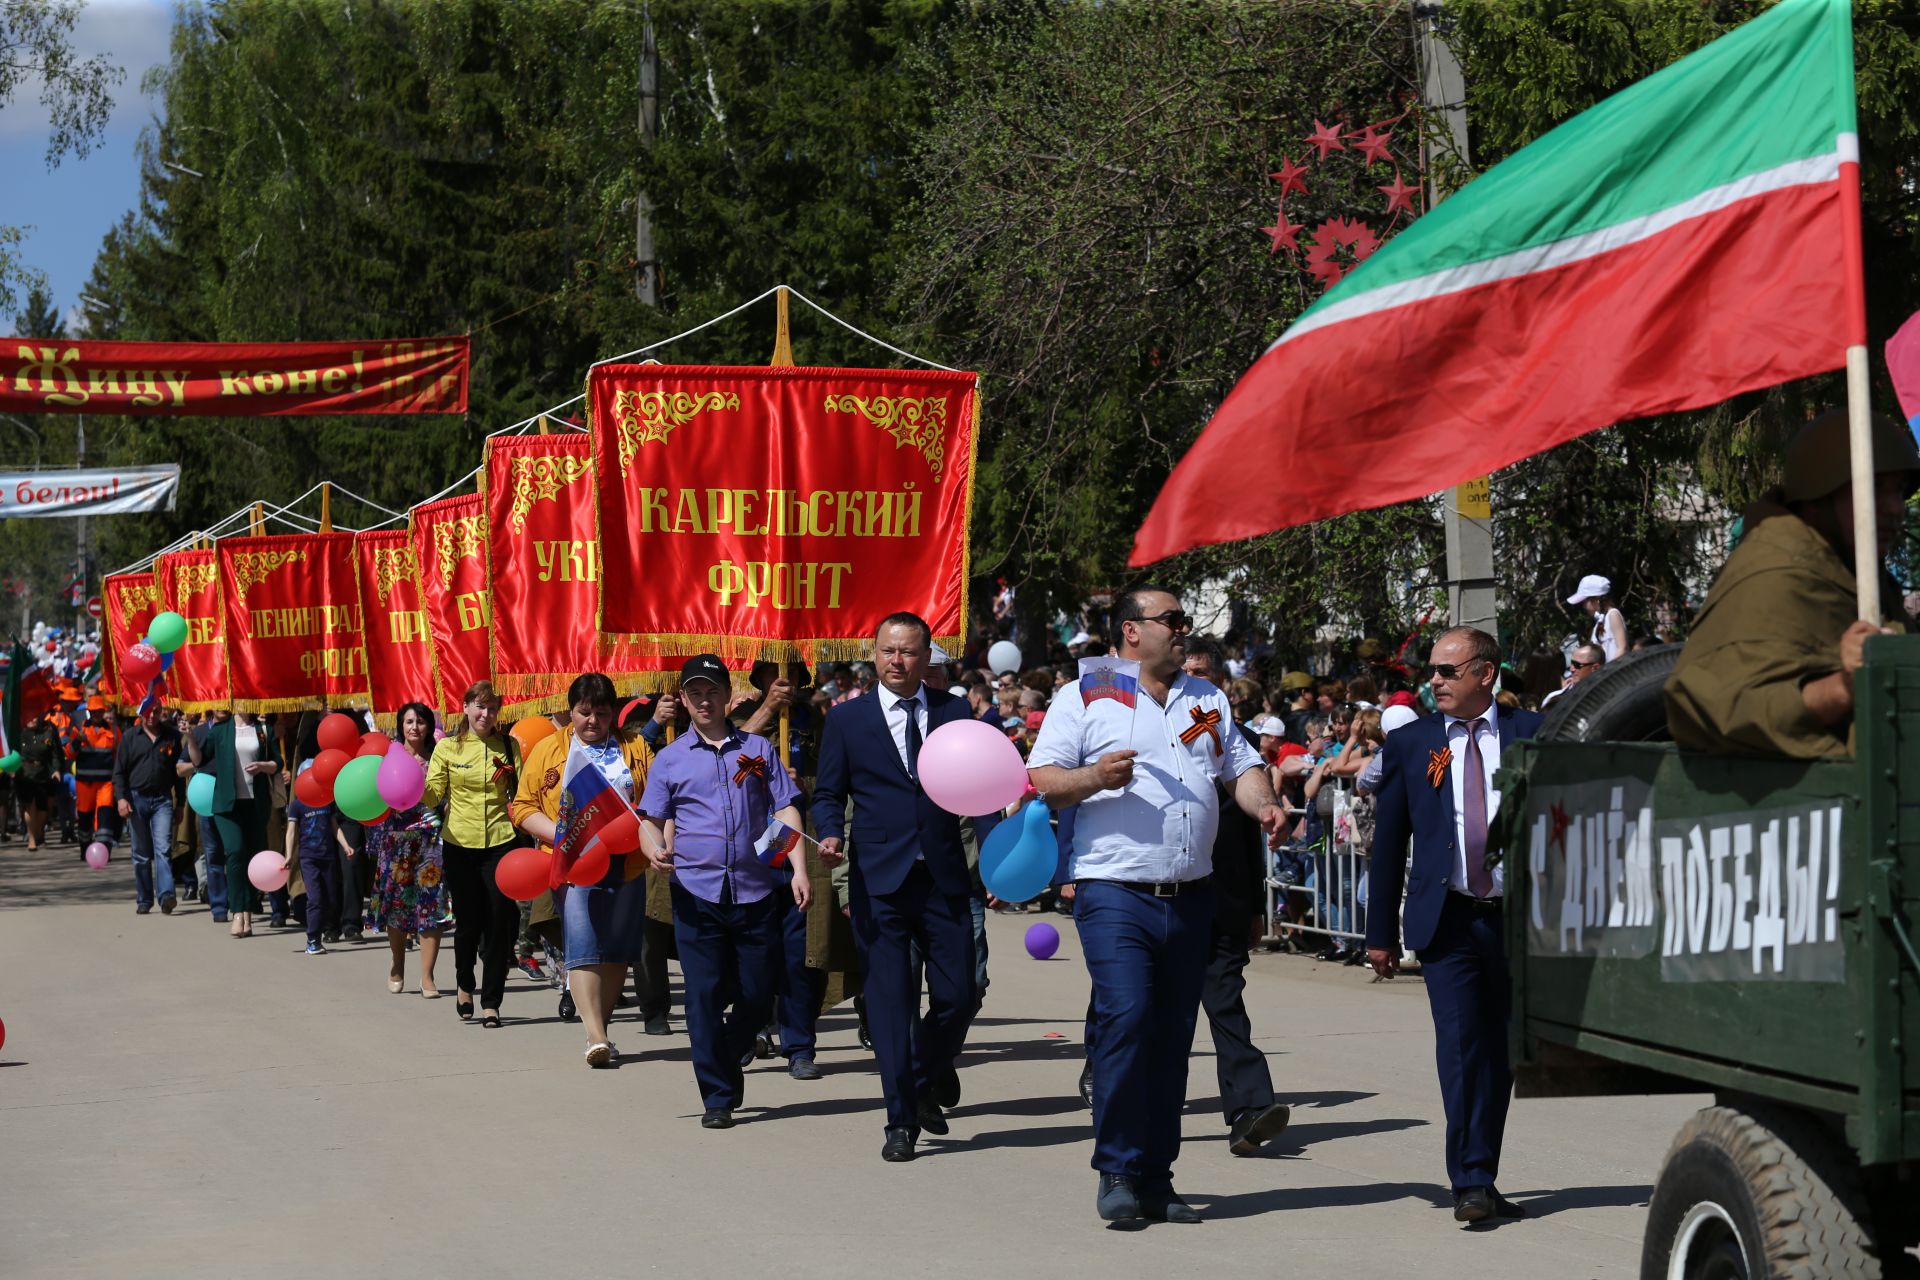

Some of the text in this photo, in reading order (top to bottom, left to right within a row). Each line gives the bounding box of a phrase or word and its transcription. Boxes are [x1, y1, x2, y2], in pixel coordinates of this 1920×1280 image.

[219, 350, 365, 396] көне!
[16, 478, 119, 505] белән!
[639, 481, 922, 537] КАРЕЛЬСКИЙ
[708, 559, 852, 610] ФРОНТ
[186, 617, 224, 645] БЕ
[300, 646, 367, 679] ФРОНТ
[1660, 806, 1842, 974] ПОБЕДЫ!
